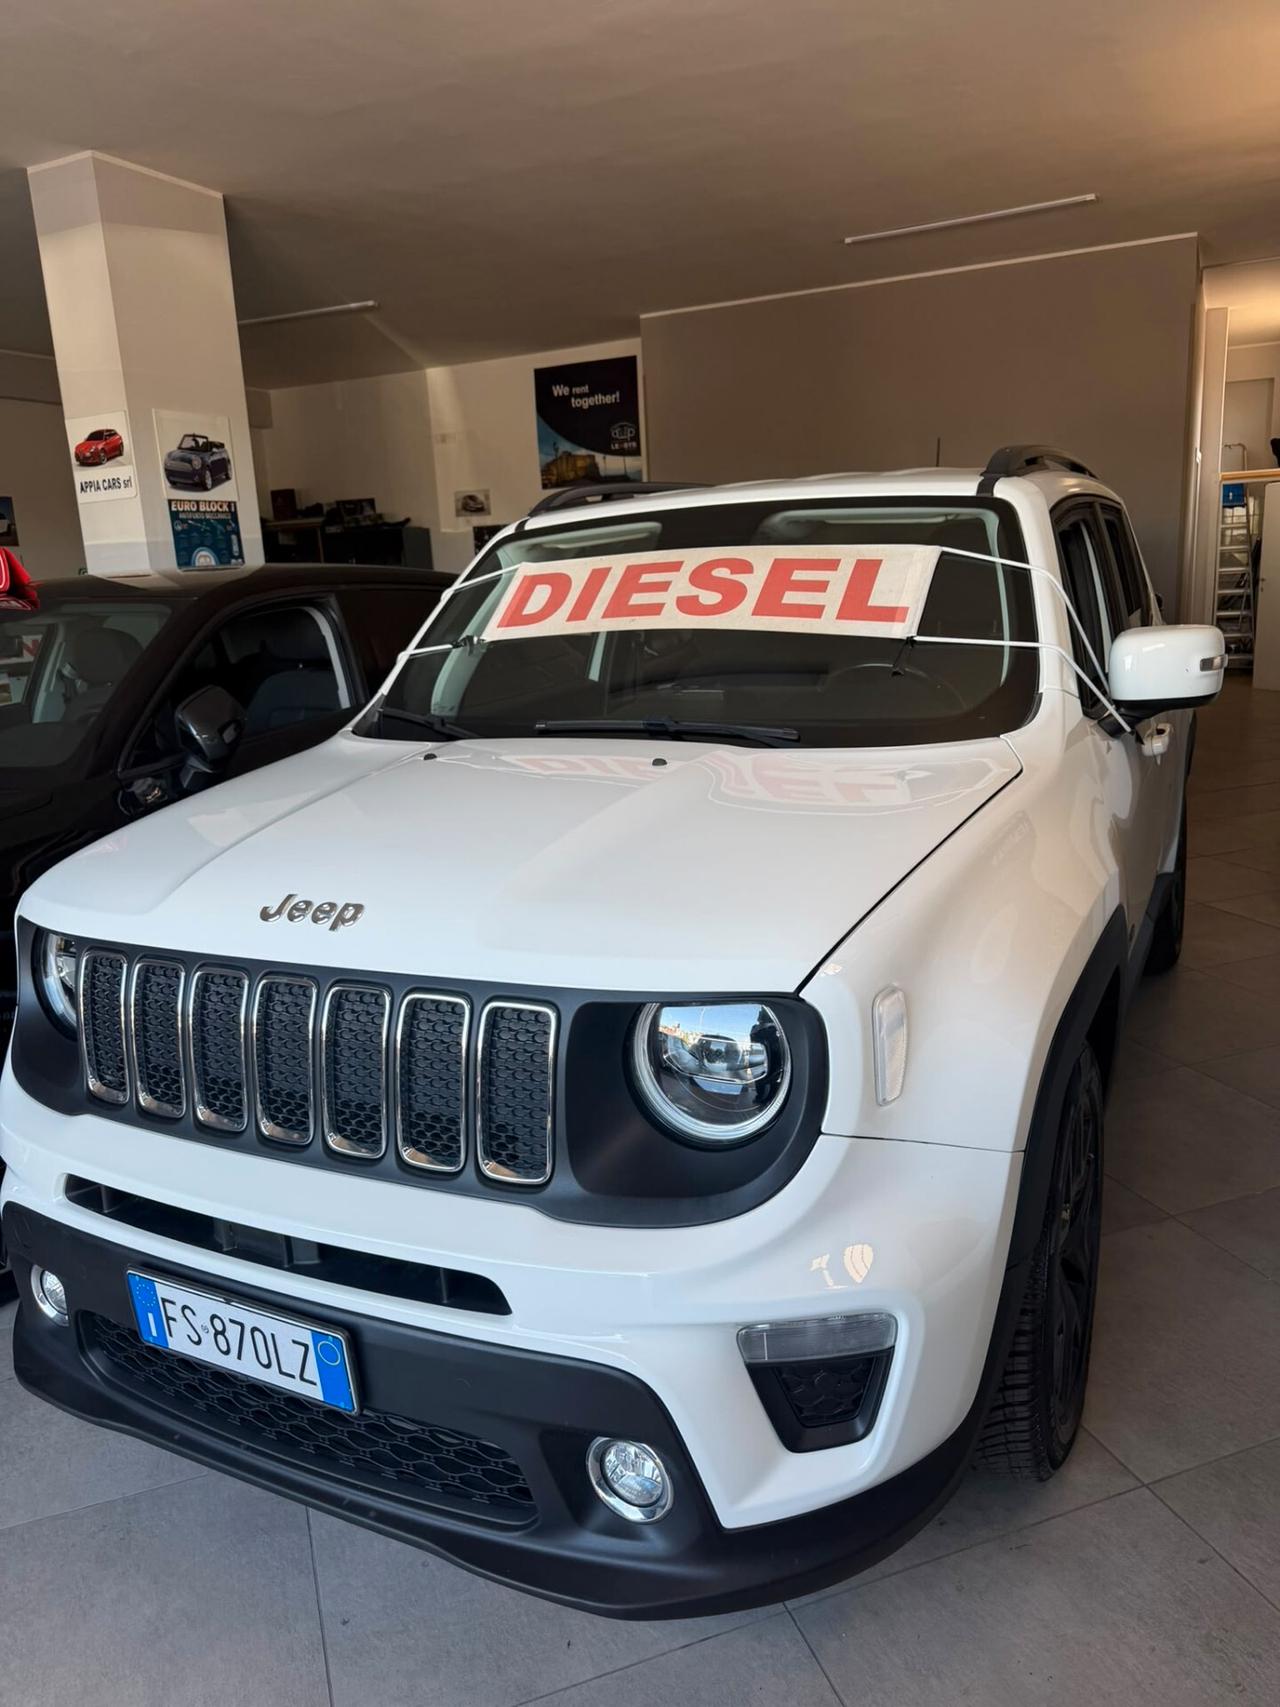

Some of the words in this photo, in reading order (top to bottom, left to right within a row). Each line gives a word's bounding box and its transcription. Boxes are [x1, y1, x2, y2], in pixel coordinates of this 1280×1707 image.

[552, 385, 569, 397] We
[572, 385, 589, 395] rent
[571, 391, 620, 409] together!
[80, 479, 102, 494] APPIA
[102, 477, 122, 491] CARS
[123, 476, 133, 488] srl
[171, 501, 197, 512] EURO
[199, 501, 229, 512] BLOCK
[497, 557, 909, 630] DIESEL
[260, 894, 364, 932] Jeep
